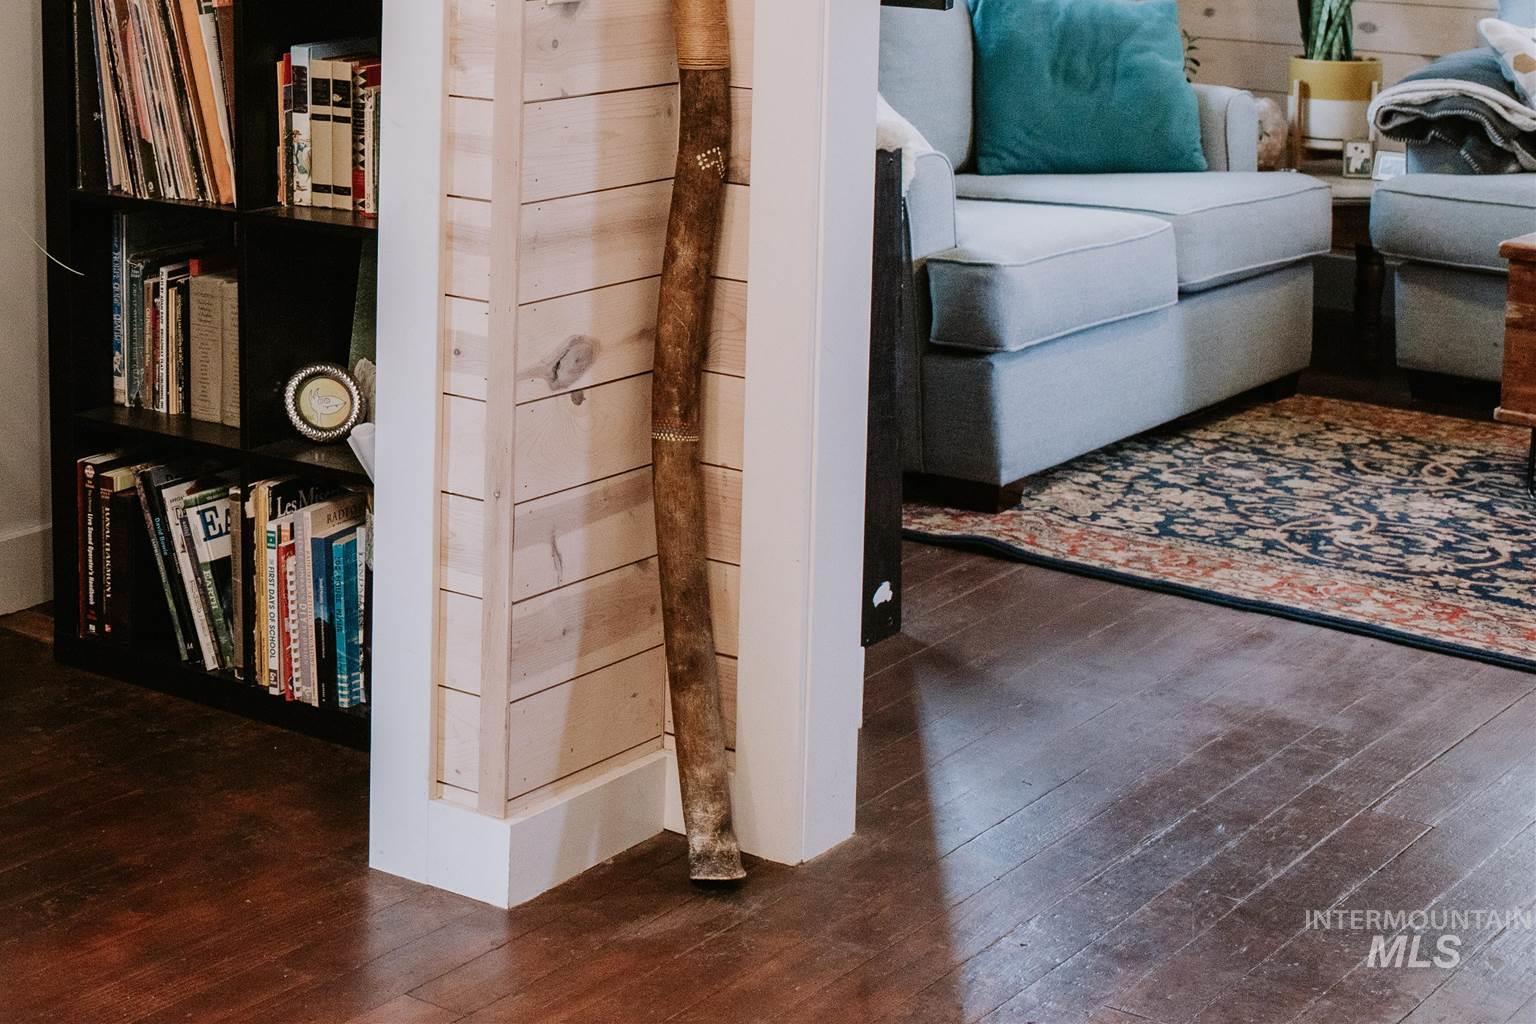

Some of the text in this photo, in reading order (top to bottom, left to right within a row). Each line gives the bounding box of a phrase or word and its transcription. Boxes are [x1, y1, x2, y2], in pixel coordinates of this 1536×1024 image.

[276, 495, 297, 517] Les
[154, 518, 163, 535] David
[203, 570, 218, 609] EARTH
[269, 611, 276, 622] OF
